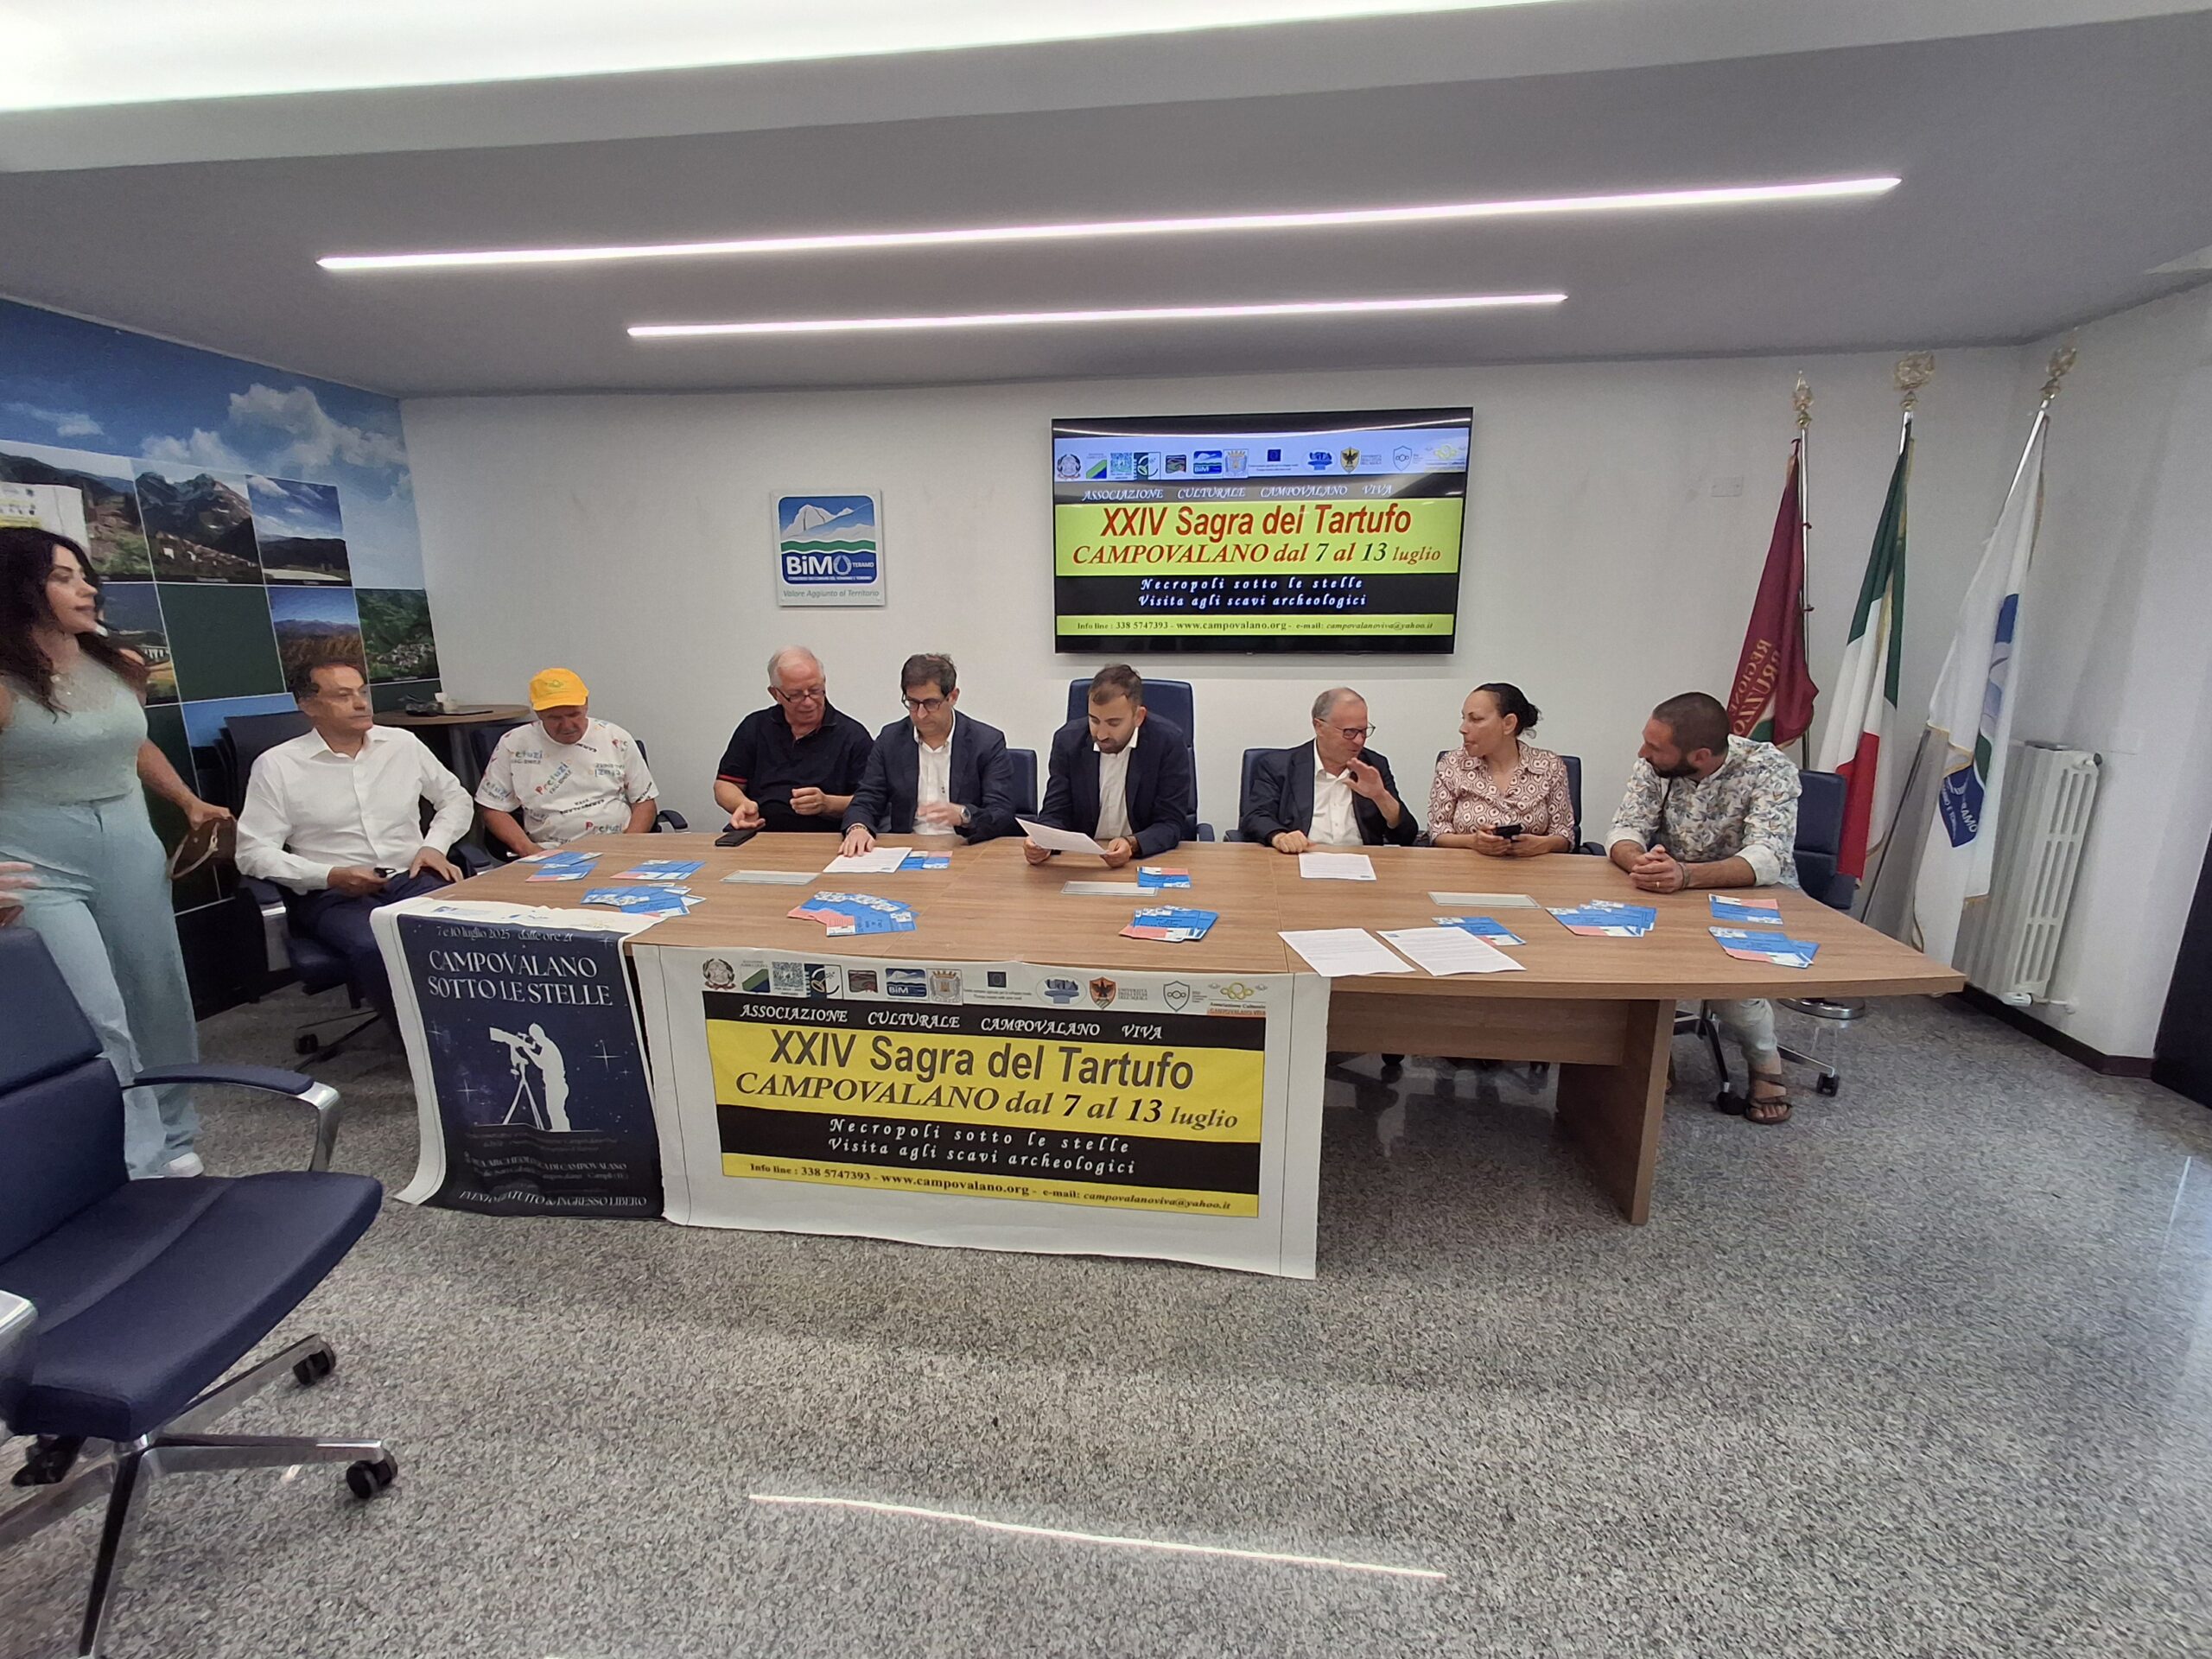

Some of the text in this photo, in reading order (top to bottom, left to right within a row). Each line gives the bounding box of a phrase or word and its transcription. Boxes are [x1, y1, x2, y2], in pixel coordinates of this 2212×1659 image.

[1082, 484, 1392, 501] ASSOCIAZIONE CULTURALE CAMPOVALANO VIVA
[1100, 503, 1411, 543] XXIV Sagra del Tartufo
[1072, 543, 1441, 565] CAMPOVALANO dal 7 al 13 luglio
[1140, 576, 1363, 593] Necropoli sotto le stelle
[1138, 594, 1366, 609] Visita agli scavi archeologici
[1116, 621, 1131, 630] 338
[1133, 621, 1168, 630] 5747393
[1176, 620, 1287, 632] www.campovalano.org
[1326, 621, 1433, 632] campovalanoviva@yahoo.it
[436, 925, 442, 937] 7
[442, 929, 449, 938] e
[451, 926, 461, 938] 10
[488, 929, 511, 940] 2025
[543, 933, 562, 942] ore
[429, 950, 597, 978] CAMPOVALANO
[428, 975, 613, 1007] SOTTO LE STELLE
[740, 1003, 1162, 1040] ASSOCIAZIONE CULTURALE CAMPOVALANO VIVA
[769, 1028, 1193, 1090] XXIV Sagra del Tartufo
[736, 1071, 1238, 1131] CAMPOVALANO dal 7 al 13 luglio
[829, 1118, 1129, 1153] Necropoli sotto le stelle
[828, 1138, 1135, 1176] Visita agli scavi archeologici
[556, 1196, 608, 1206] INGRESSO
[608, 1196, 647, 1206] LIBERO
[750, 1163, 771, 1173] Info
[773, 1165, 792, 1175] line
[801, 1166, 821, 1177] 338
[824, 1168, 871, 1181] 5747393
[881, 1174, 1030, 1197] www.campovalano.org
[1043, 1188, 1080, 1199] e-mail:
[1084, 1192, 1231, 1210] campovalanoviva@yahoo.it
